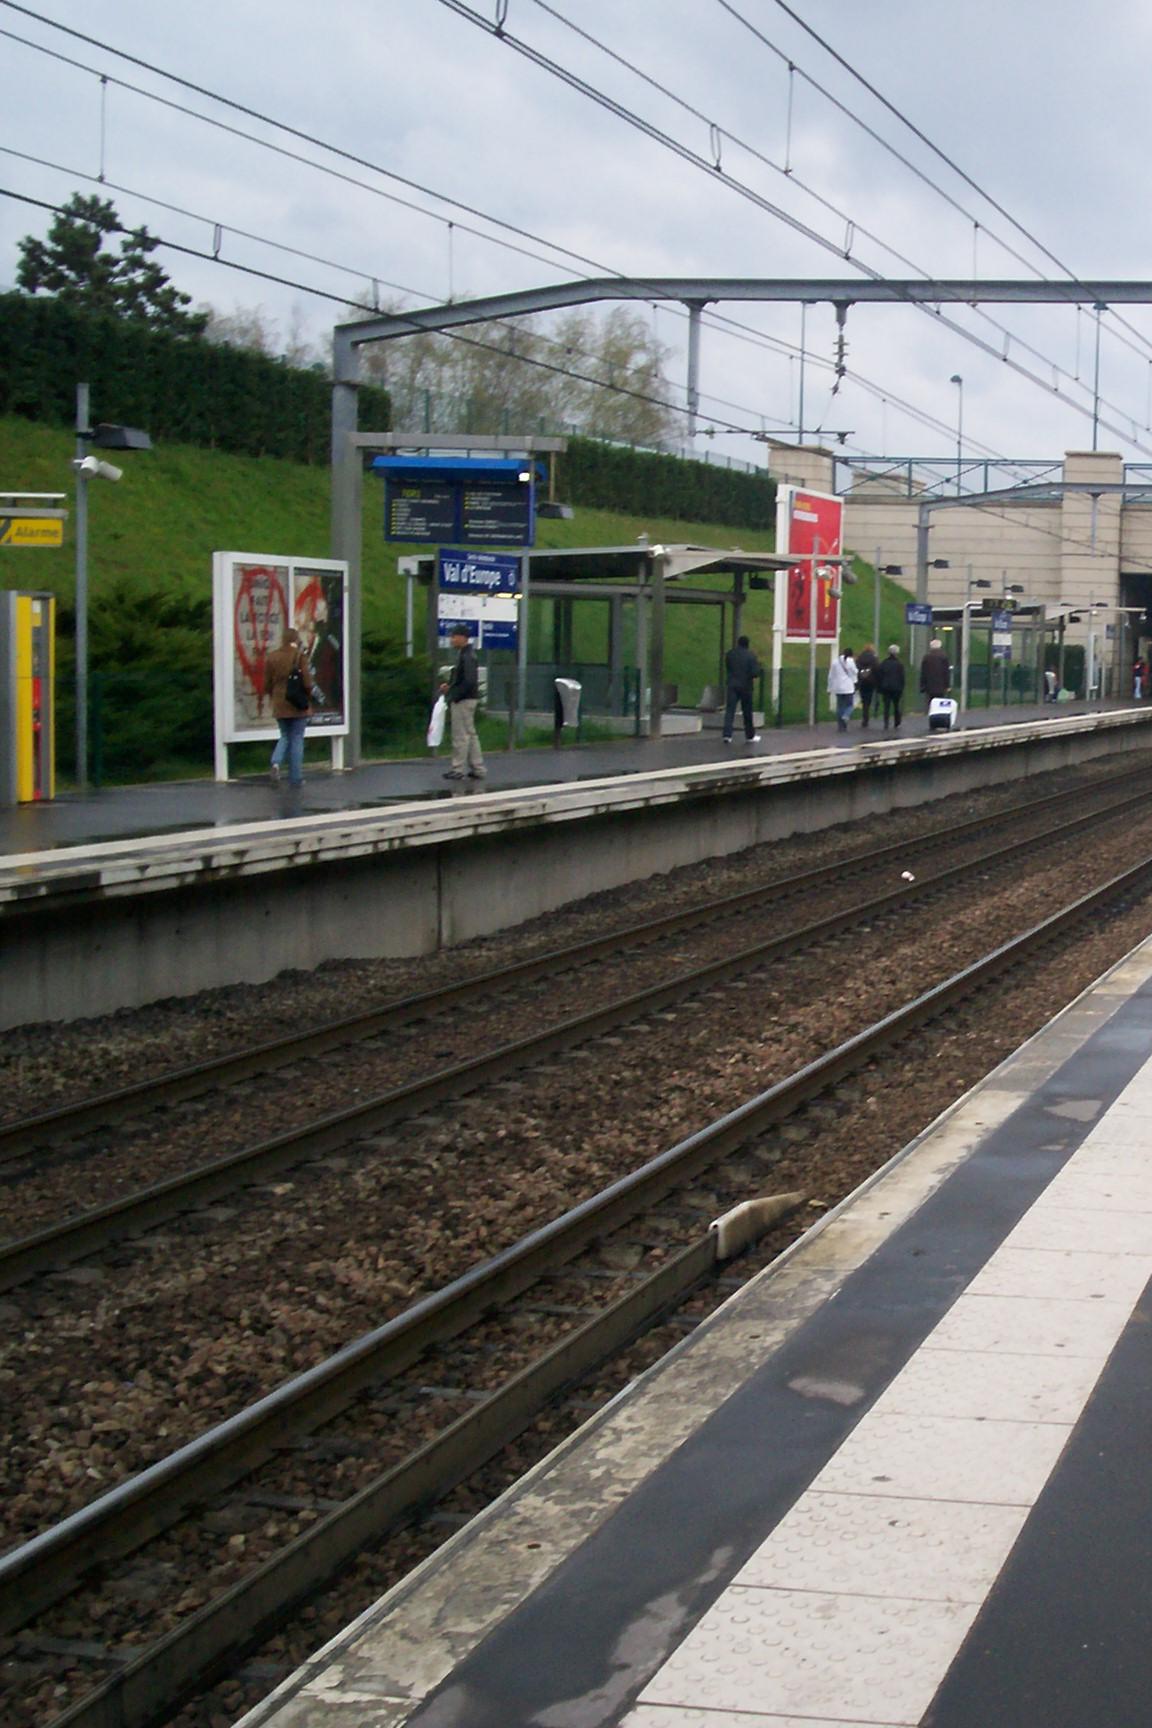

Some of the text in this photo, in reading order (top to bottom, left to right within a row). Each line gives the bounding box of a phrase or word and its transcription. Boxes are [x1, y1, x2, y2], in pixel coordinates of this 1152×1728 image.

[15, 526, 59, 538] Alarme
[443, 562, 501, 589] Val d'Europe
